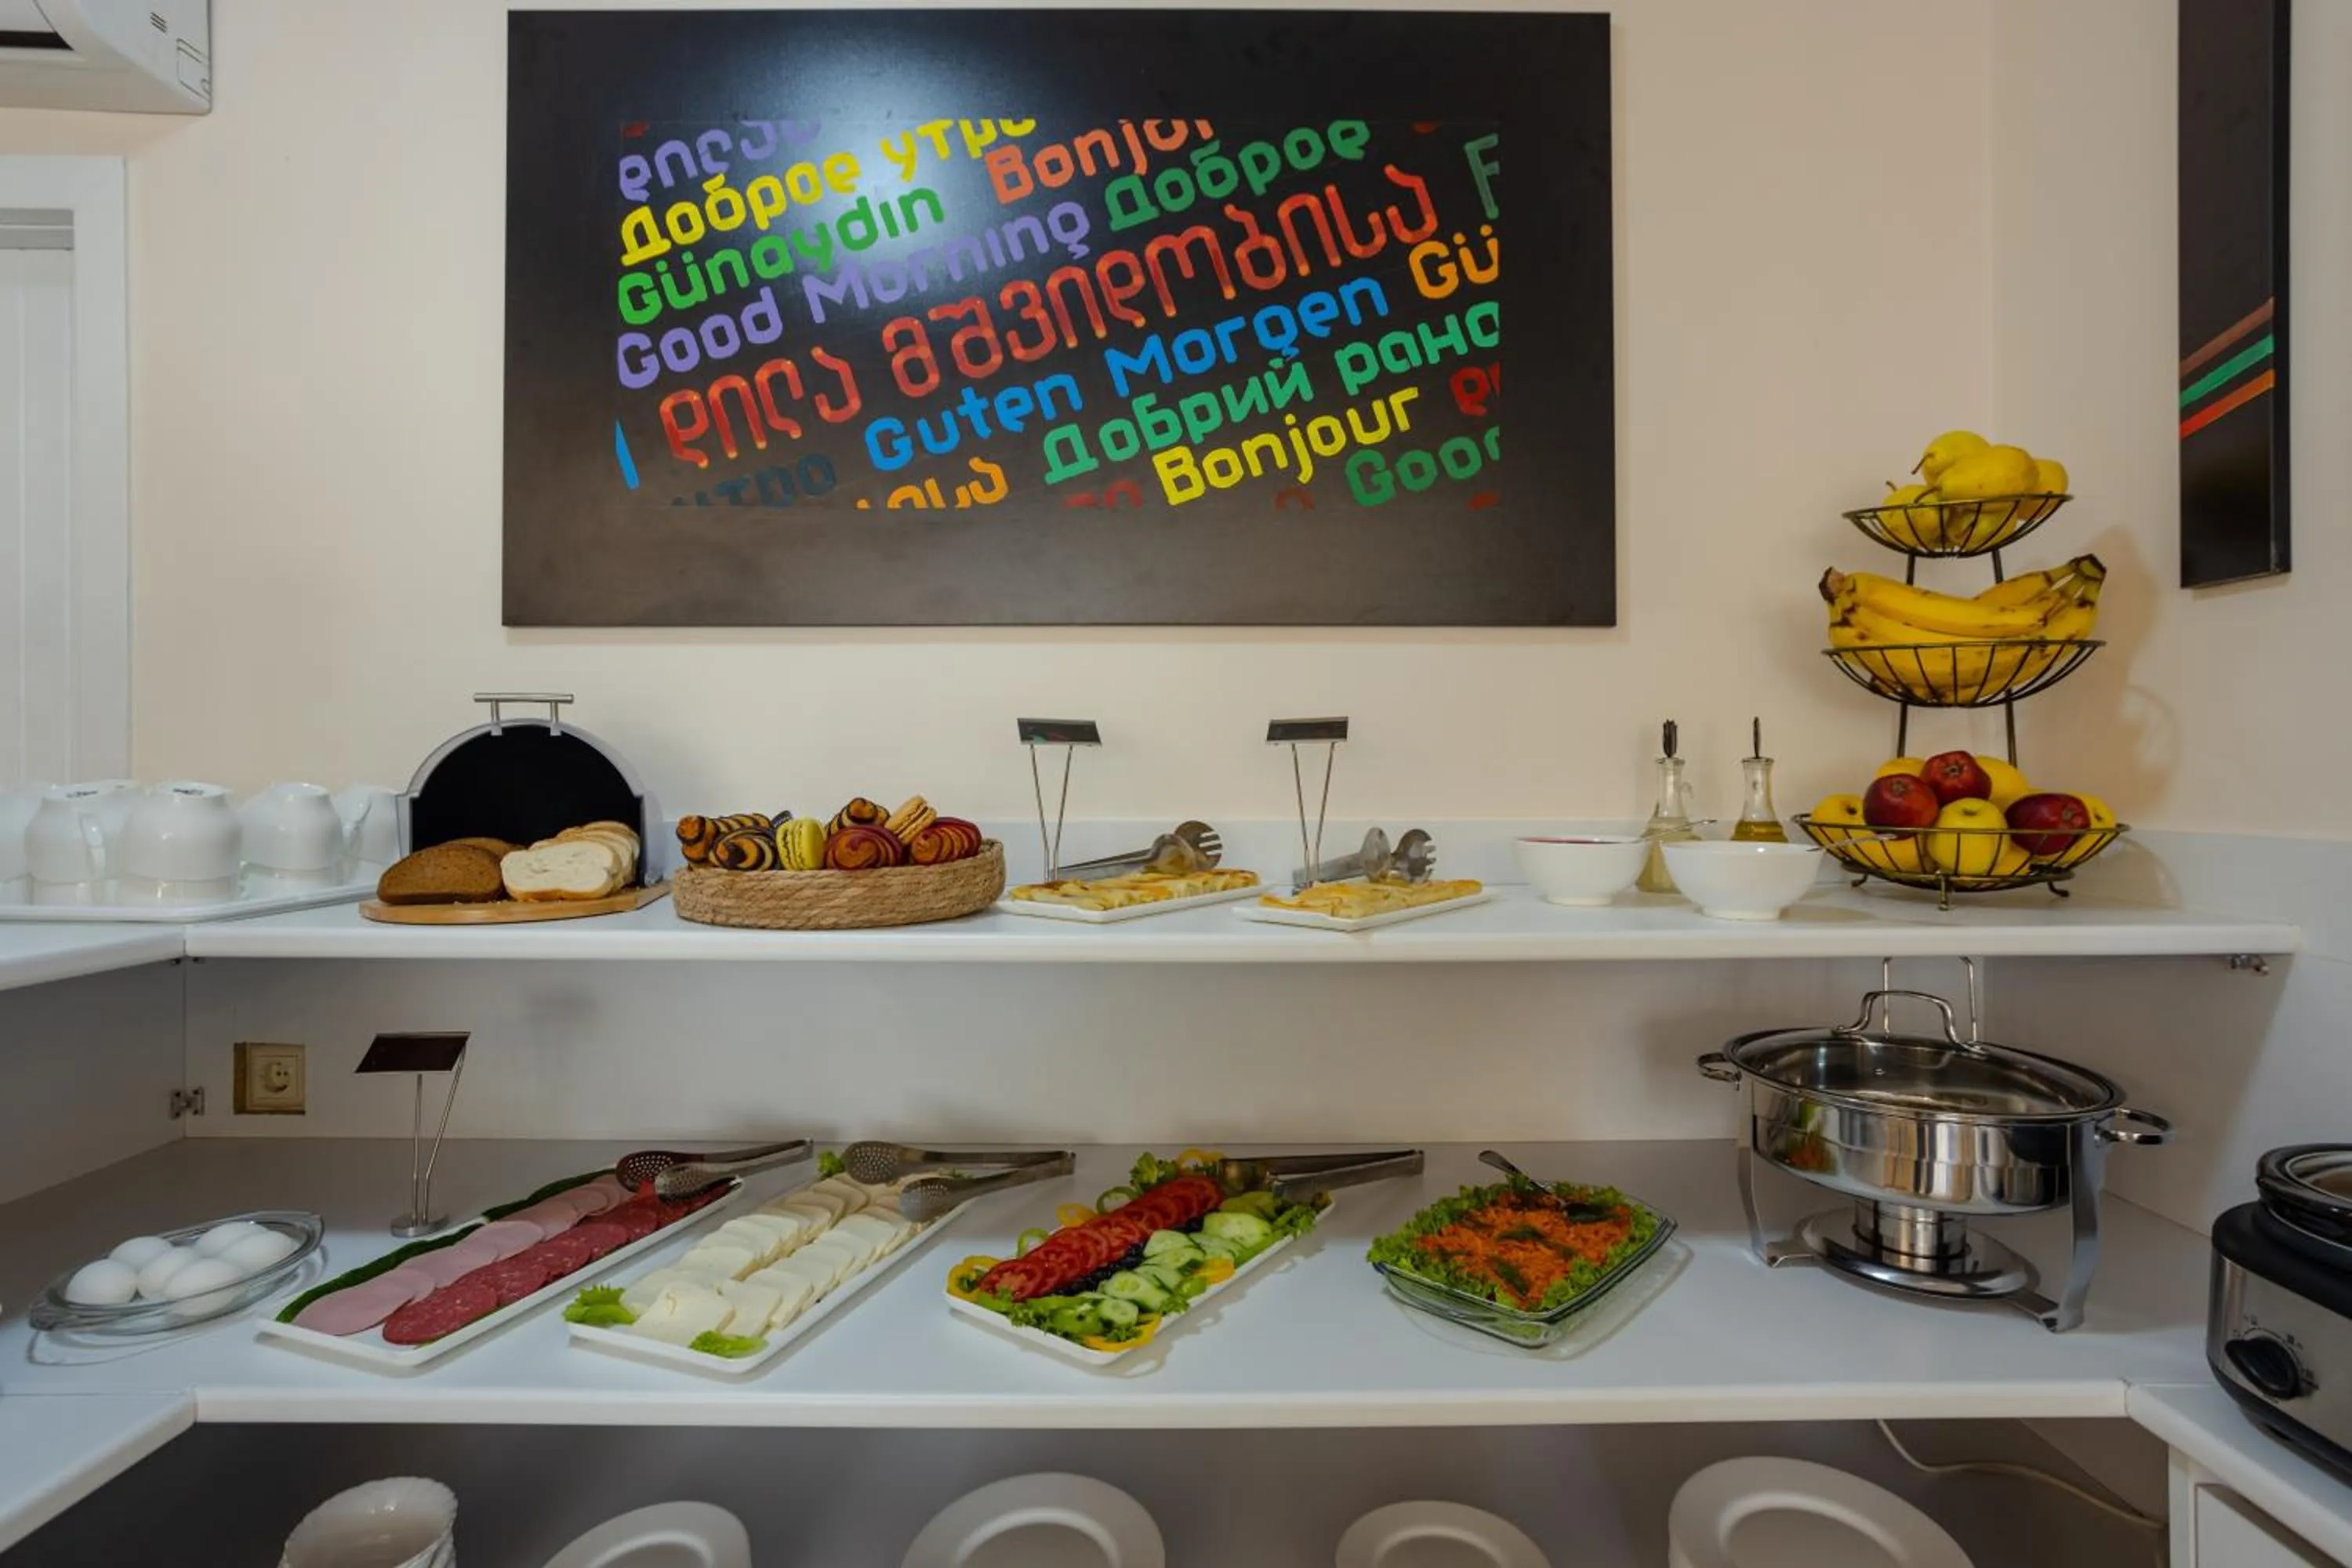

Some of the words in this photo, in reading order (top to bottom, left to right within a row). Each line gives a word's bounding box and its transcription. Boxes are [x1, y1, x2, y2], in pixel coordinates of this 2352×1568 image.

[622, 152, 860, 266] Доброе
[1105, 120, 1370, 232] Доброе
[617, 286, 782, 389] Good
[864, 374, 1083, 471] Guten
[1104, 277, 1389, 397] Morgen
[659, 346, 862, 468] დილა
[1044, 357, 1315, 485] Добрий
[1152, 387, 1418, 506] Bonjour
